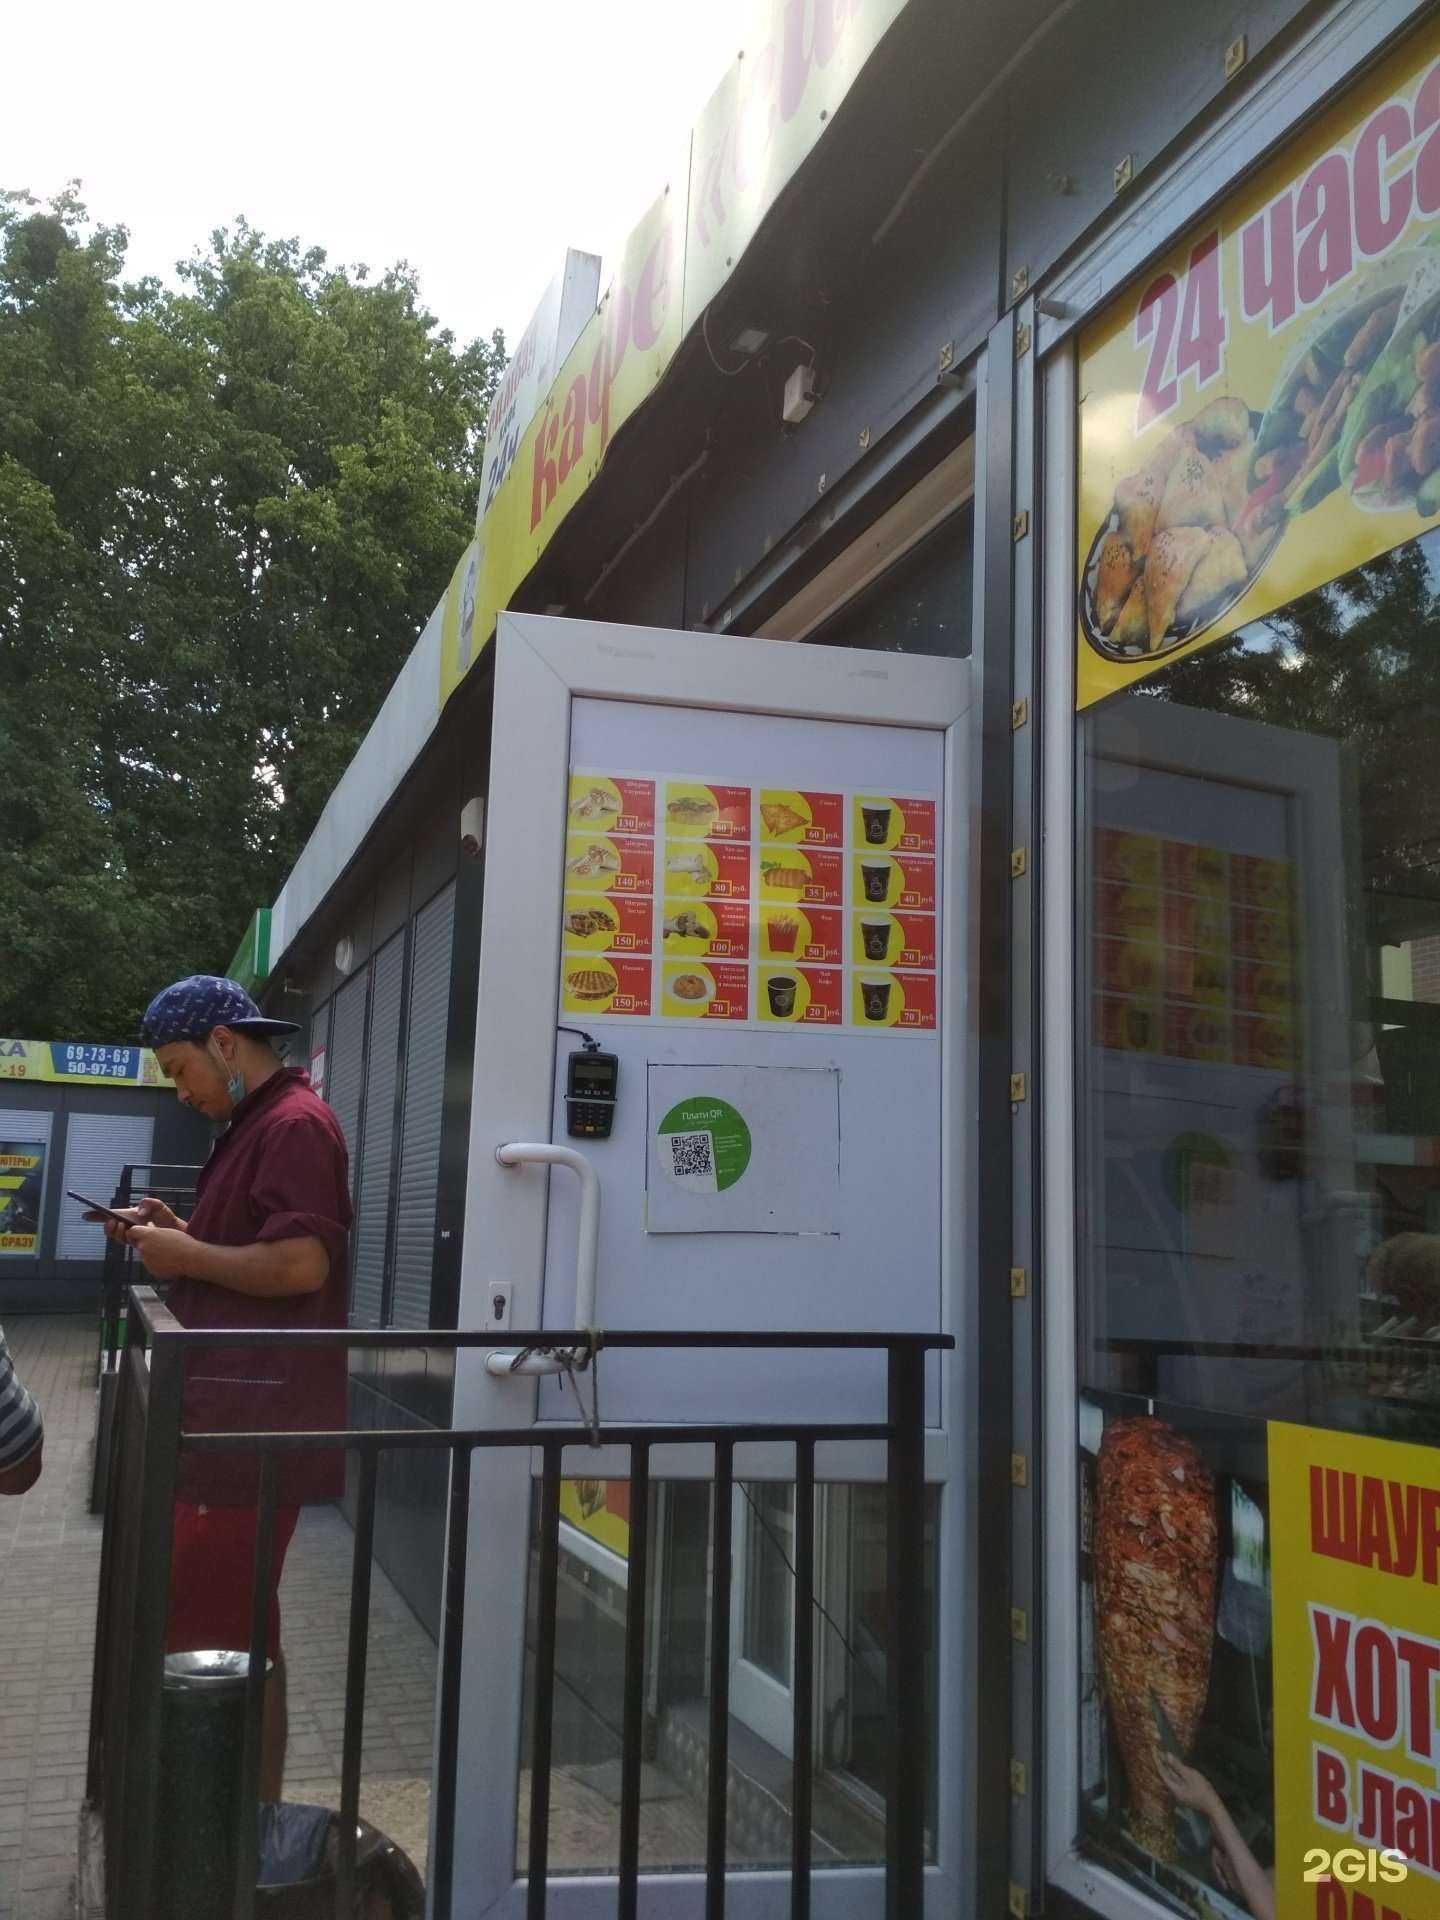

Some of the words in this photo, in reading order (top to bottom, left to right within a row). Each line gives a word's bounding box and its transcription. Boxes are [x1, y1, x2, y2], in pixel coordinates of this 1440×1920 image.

[1134, 225, 1229, 437] 24
[619, 819, 635, 828] 130
[809, 832, 820, 840] 60
[616, 877, 633, 886] 140
[714, 884, 727, 893] 80
[615, 937, 632, 946] 150
[711, 943, 728, 952] 100
[808, 947, 820, 956] 50
[903, 952, 916, 961] 70
[614, 999, 631, 1008] 150
[712, 1004, 724, 1013] 70
[809, 1008, 821, 1017] 20
[903, 1012, 916, 1022] 70
[65, 1045, 131, 1064] 69-73-63
[67, 1061, 127, 1078] 50-97-19
[709, 1108, 724, 1120] QR
